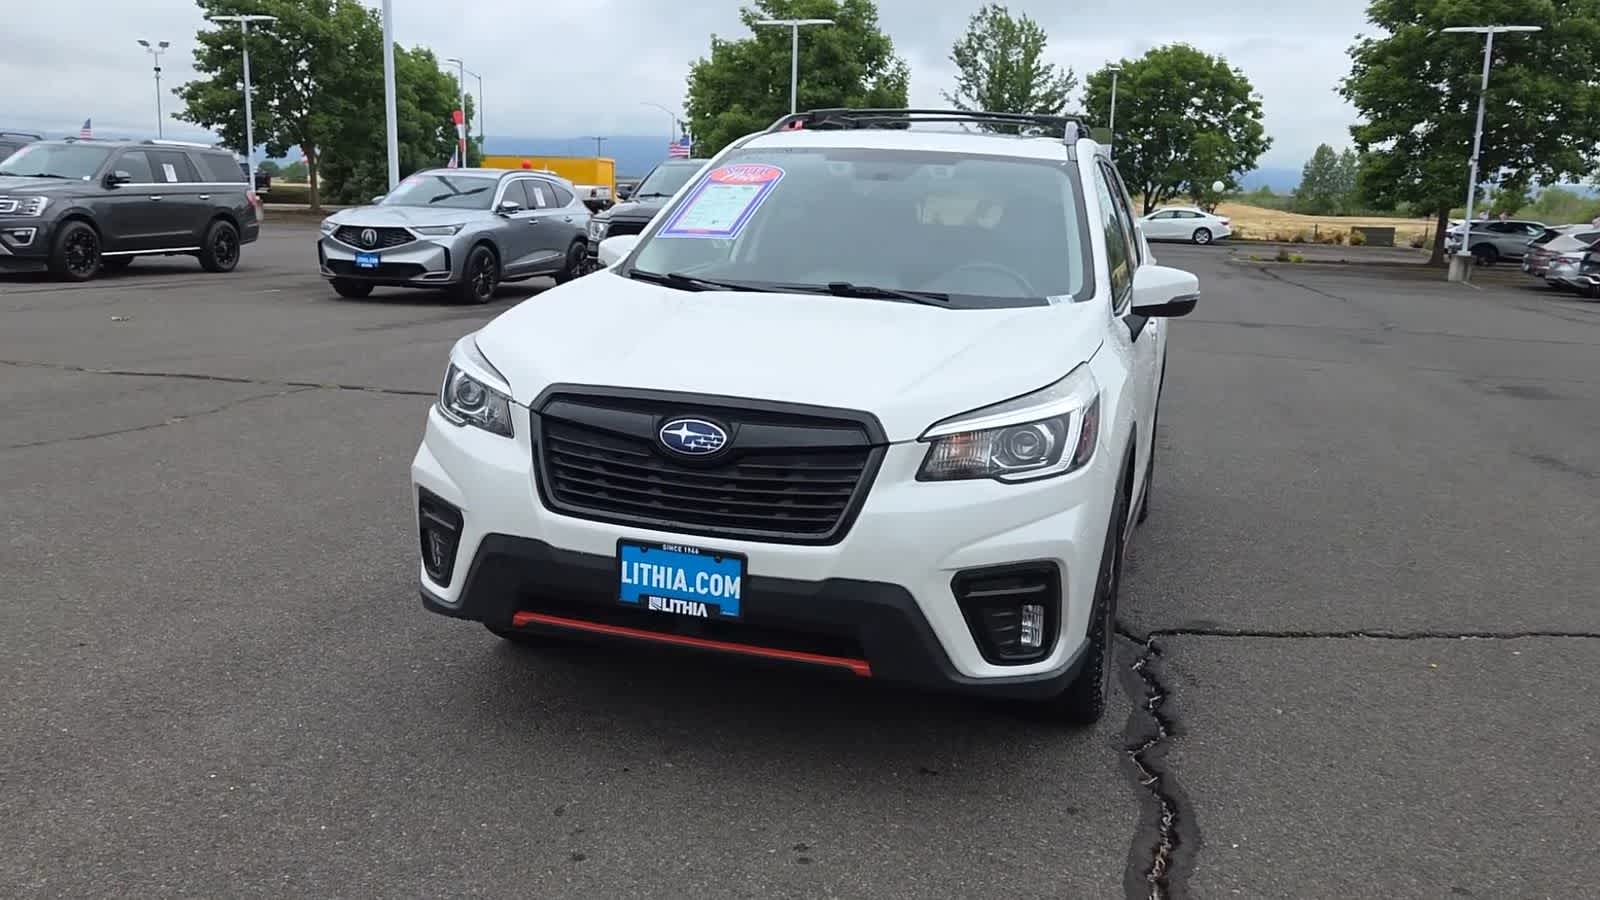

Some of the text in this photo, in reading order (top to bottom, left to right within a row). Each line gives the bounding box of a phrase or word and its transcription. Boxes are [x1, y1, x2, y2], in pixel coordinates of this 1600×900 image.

[662, 543, 682, 553] SINCE
[621, 560, 741, 599] LITHIA.COM
[661, 597, 708, 618] LITHIA
